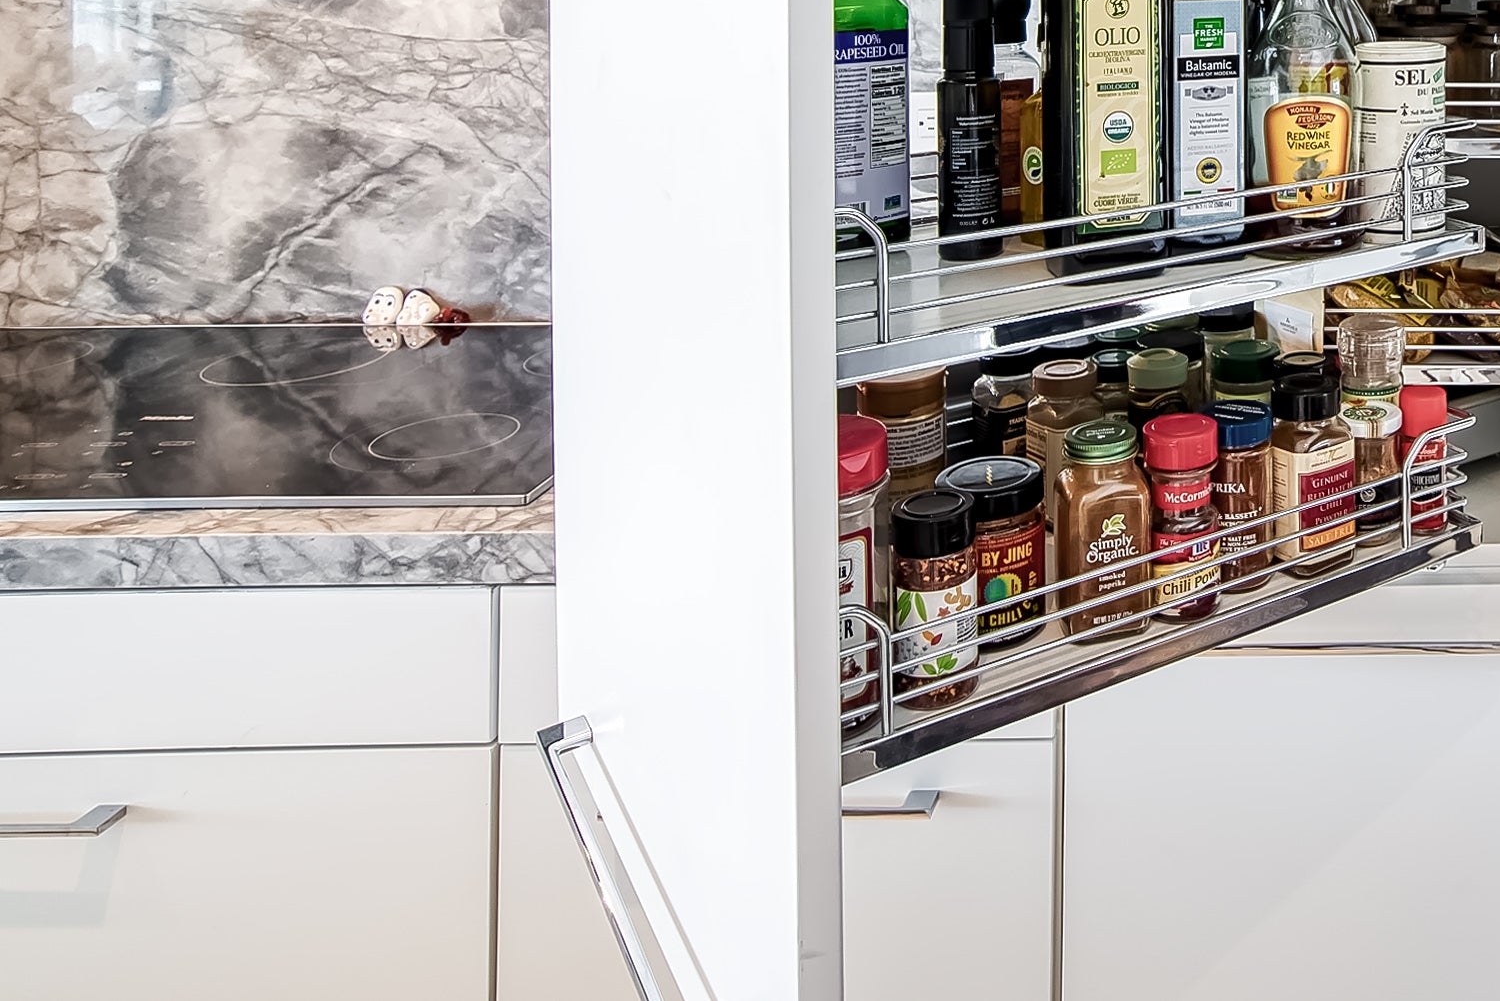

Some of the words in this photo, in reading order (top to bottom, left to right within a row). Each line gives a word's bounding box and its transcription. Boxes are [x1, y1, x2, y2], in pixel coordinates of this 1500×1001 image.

[1094, 27, 1141, 47] OLIO
[1194, 29, 1223, 37] FRESH
[854, 33, 882, 47] 100%
[834, 45, 887, 60] RAPESEED
[889, 43, 907, 56] OIL
[1103, 67, 1133, 75] ITALIANO
[1186, 59, 1232, 72] Balsamic
[1394, 69, 1431, 86] SEL
[1100, 82, 1137, 90] BIOLOGICO
[1417, 88, 1428, 96] DU
[1110, 118, 1127, 126] USDA
[1287, 141, 1331, 150] VINEGAR
[1093, 199, 1116, 208] CUORE
[1311, 469, 1349, 489] GENUINE
[1210, 482, 1246, 494] PRIKA
[1224, 509, 1258, 520] BASSETT
[1089, 533, 1134, 553] Simply
[981, 550, 1000, 567] BY
[1003, 541, 1033, 565] JING
[1098, 570, 1126, 582] smoked
[1098, 580, 1126, 592] paprika
[1162, 578, 1191, 595] Chili
